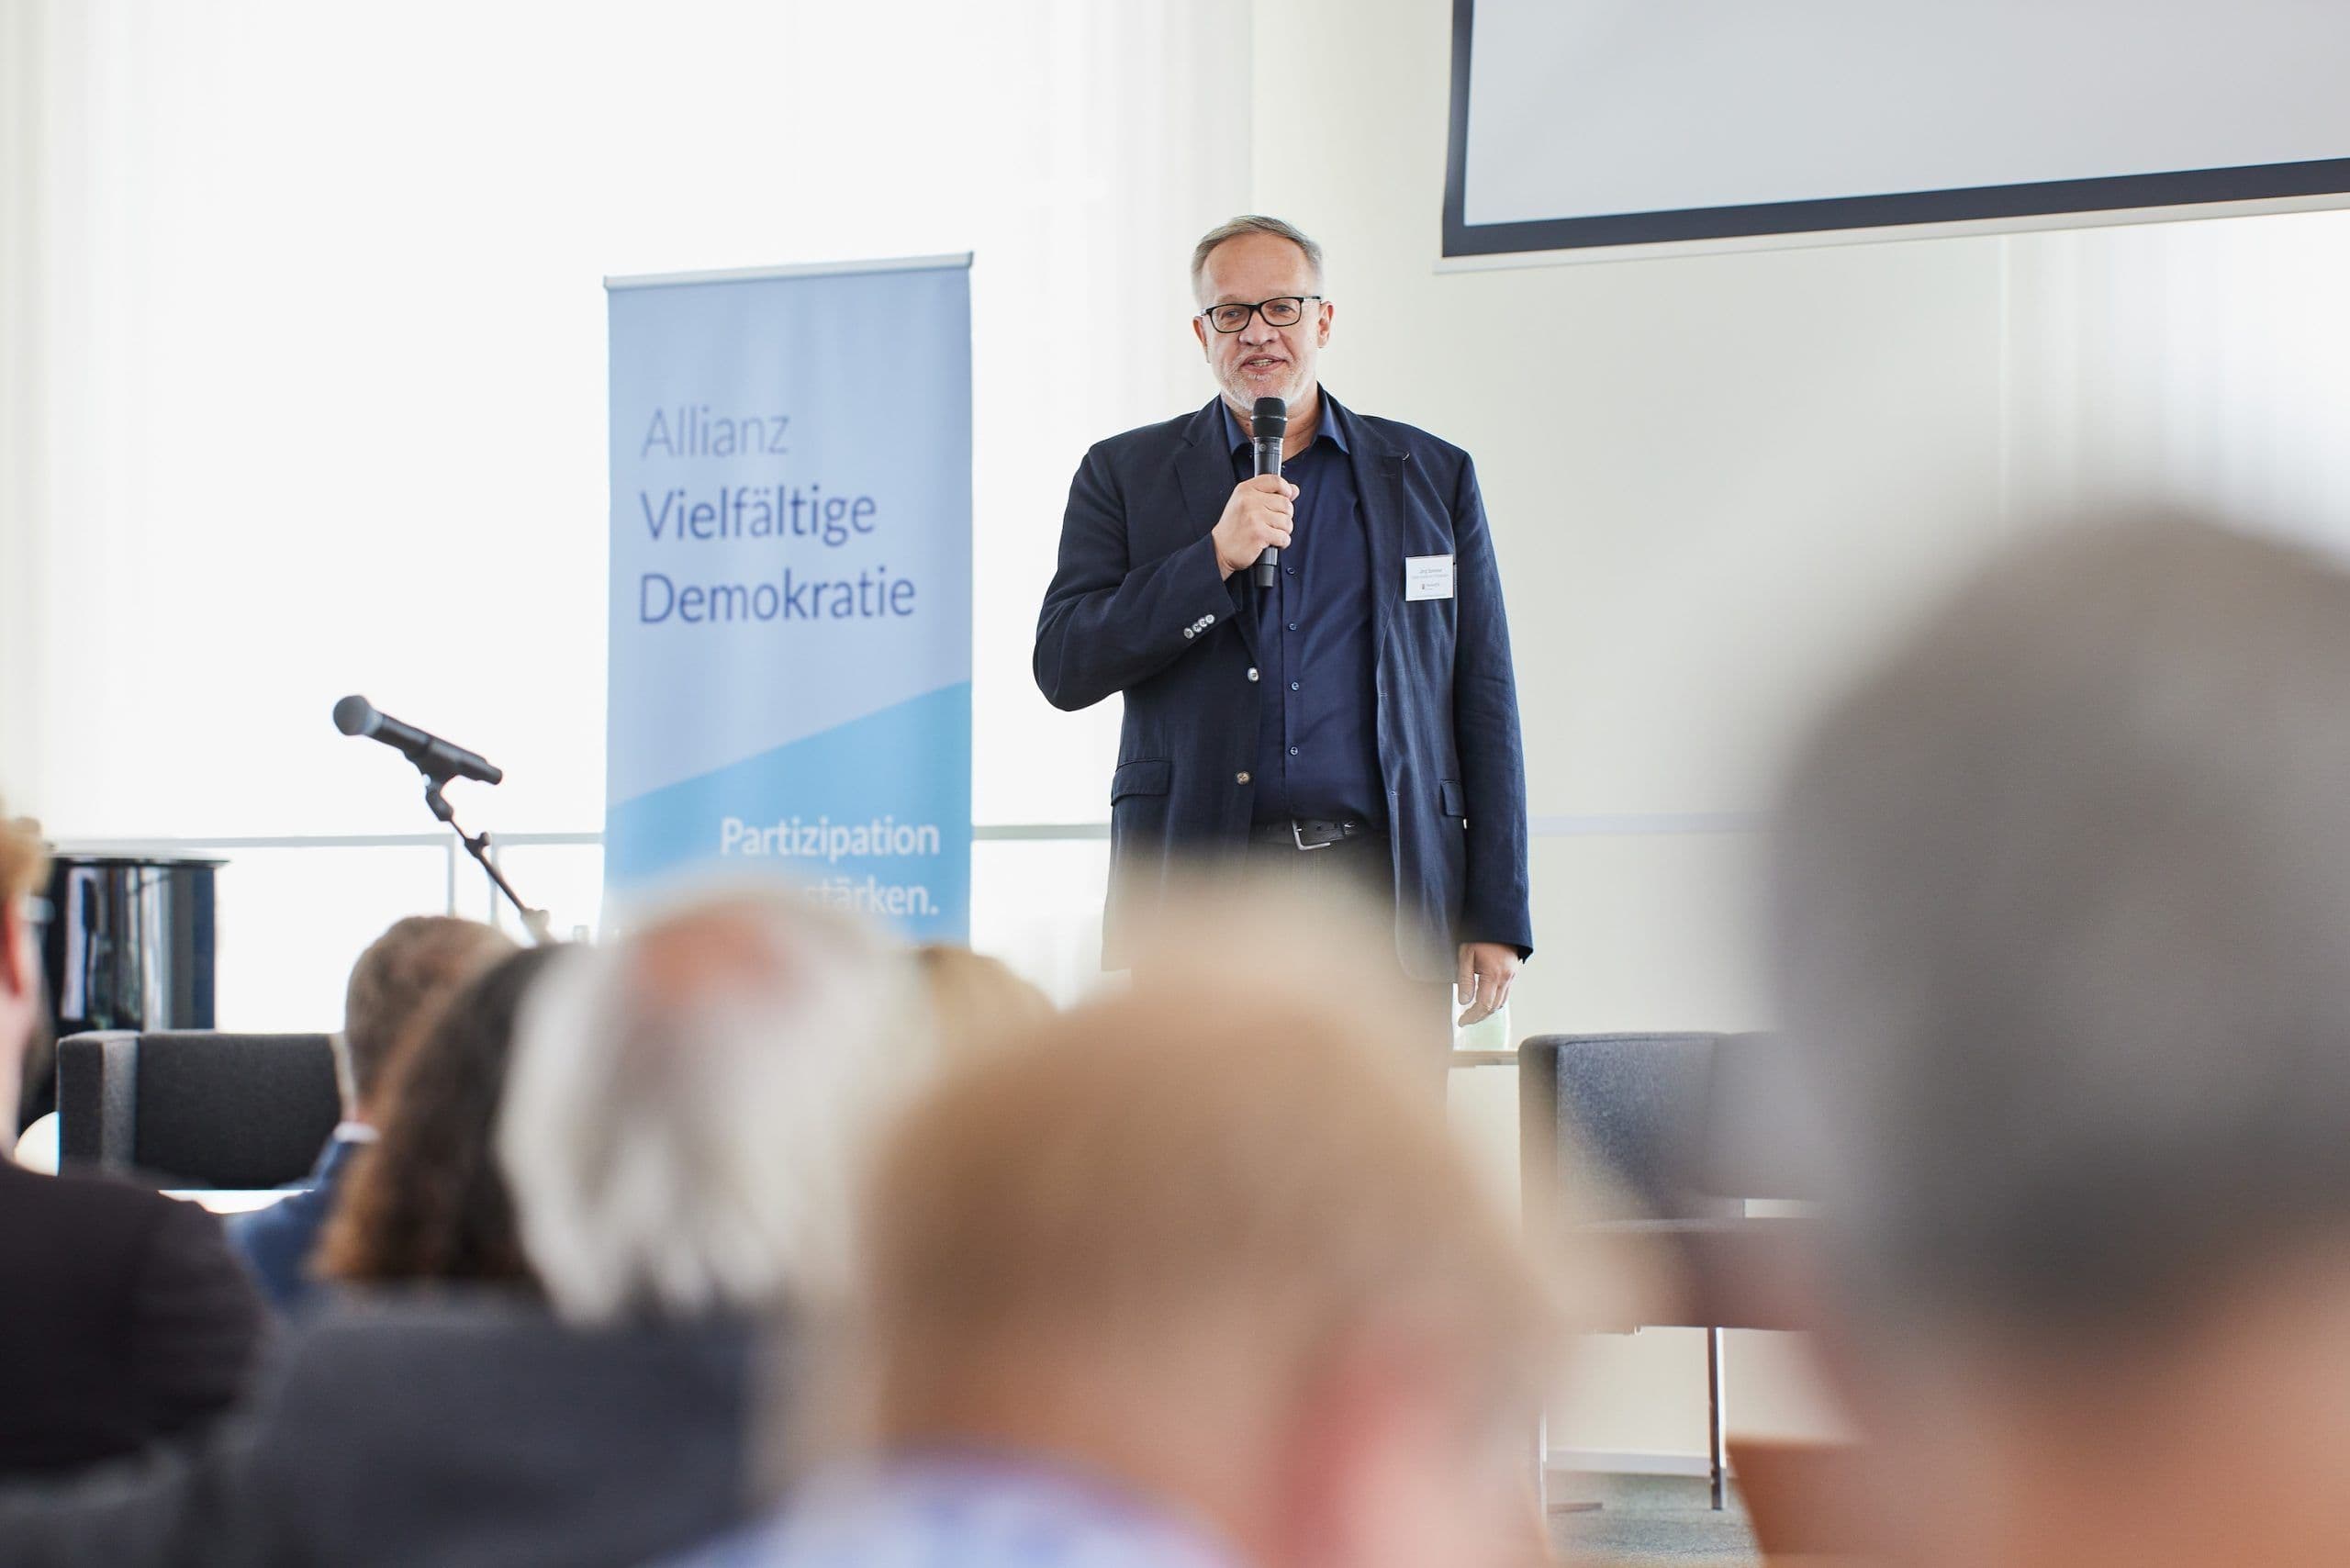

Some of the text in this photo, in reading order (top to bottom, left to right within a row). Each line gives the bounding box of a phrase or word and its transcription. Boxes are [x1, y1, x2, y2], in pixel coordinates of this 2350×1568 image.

[642, 406, 790, 458] Allianz
[640, 485, 877, 548] Vielfältige
[640, 566, 916, 624] Demokratie
[721, 815, 940, 863] Partizipation
